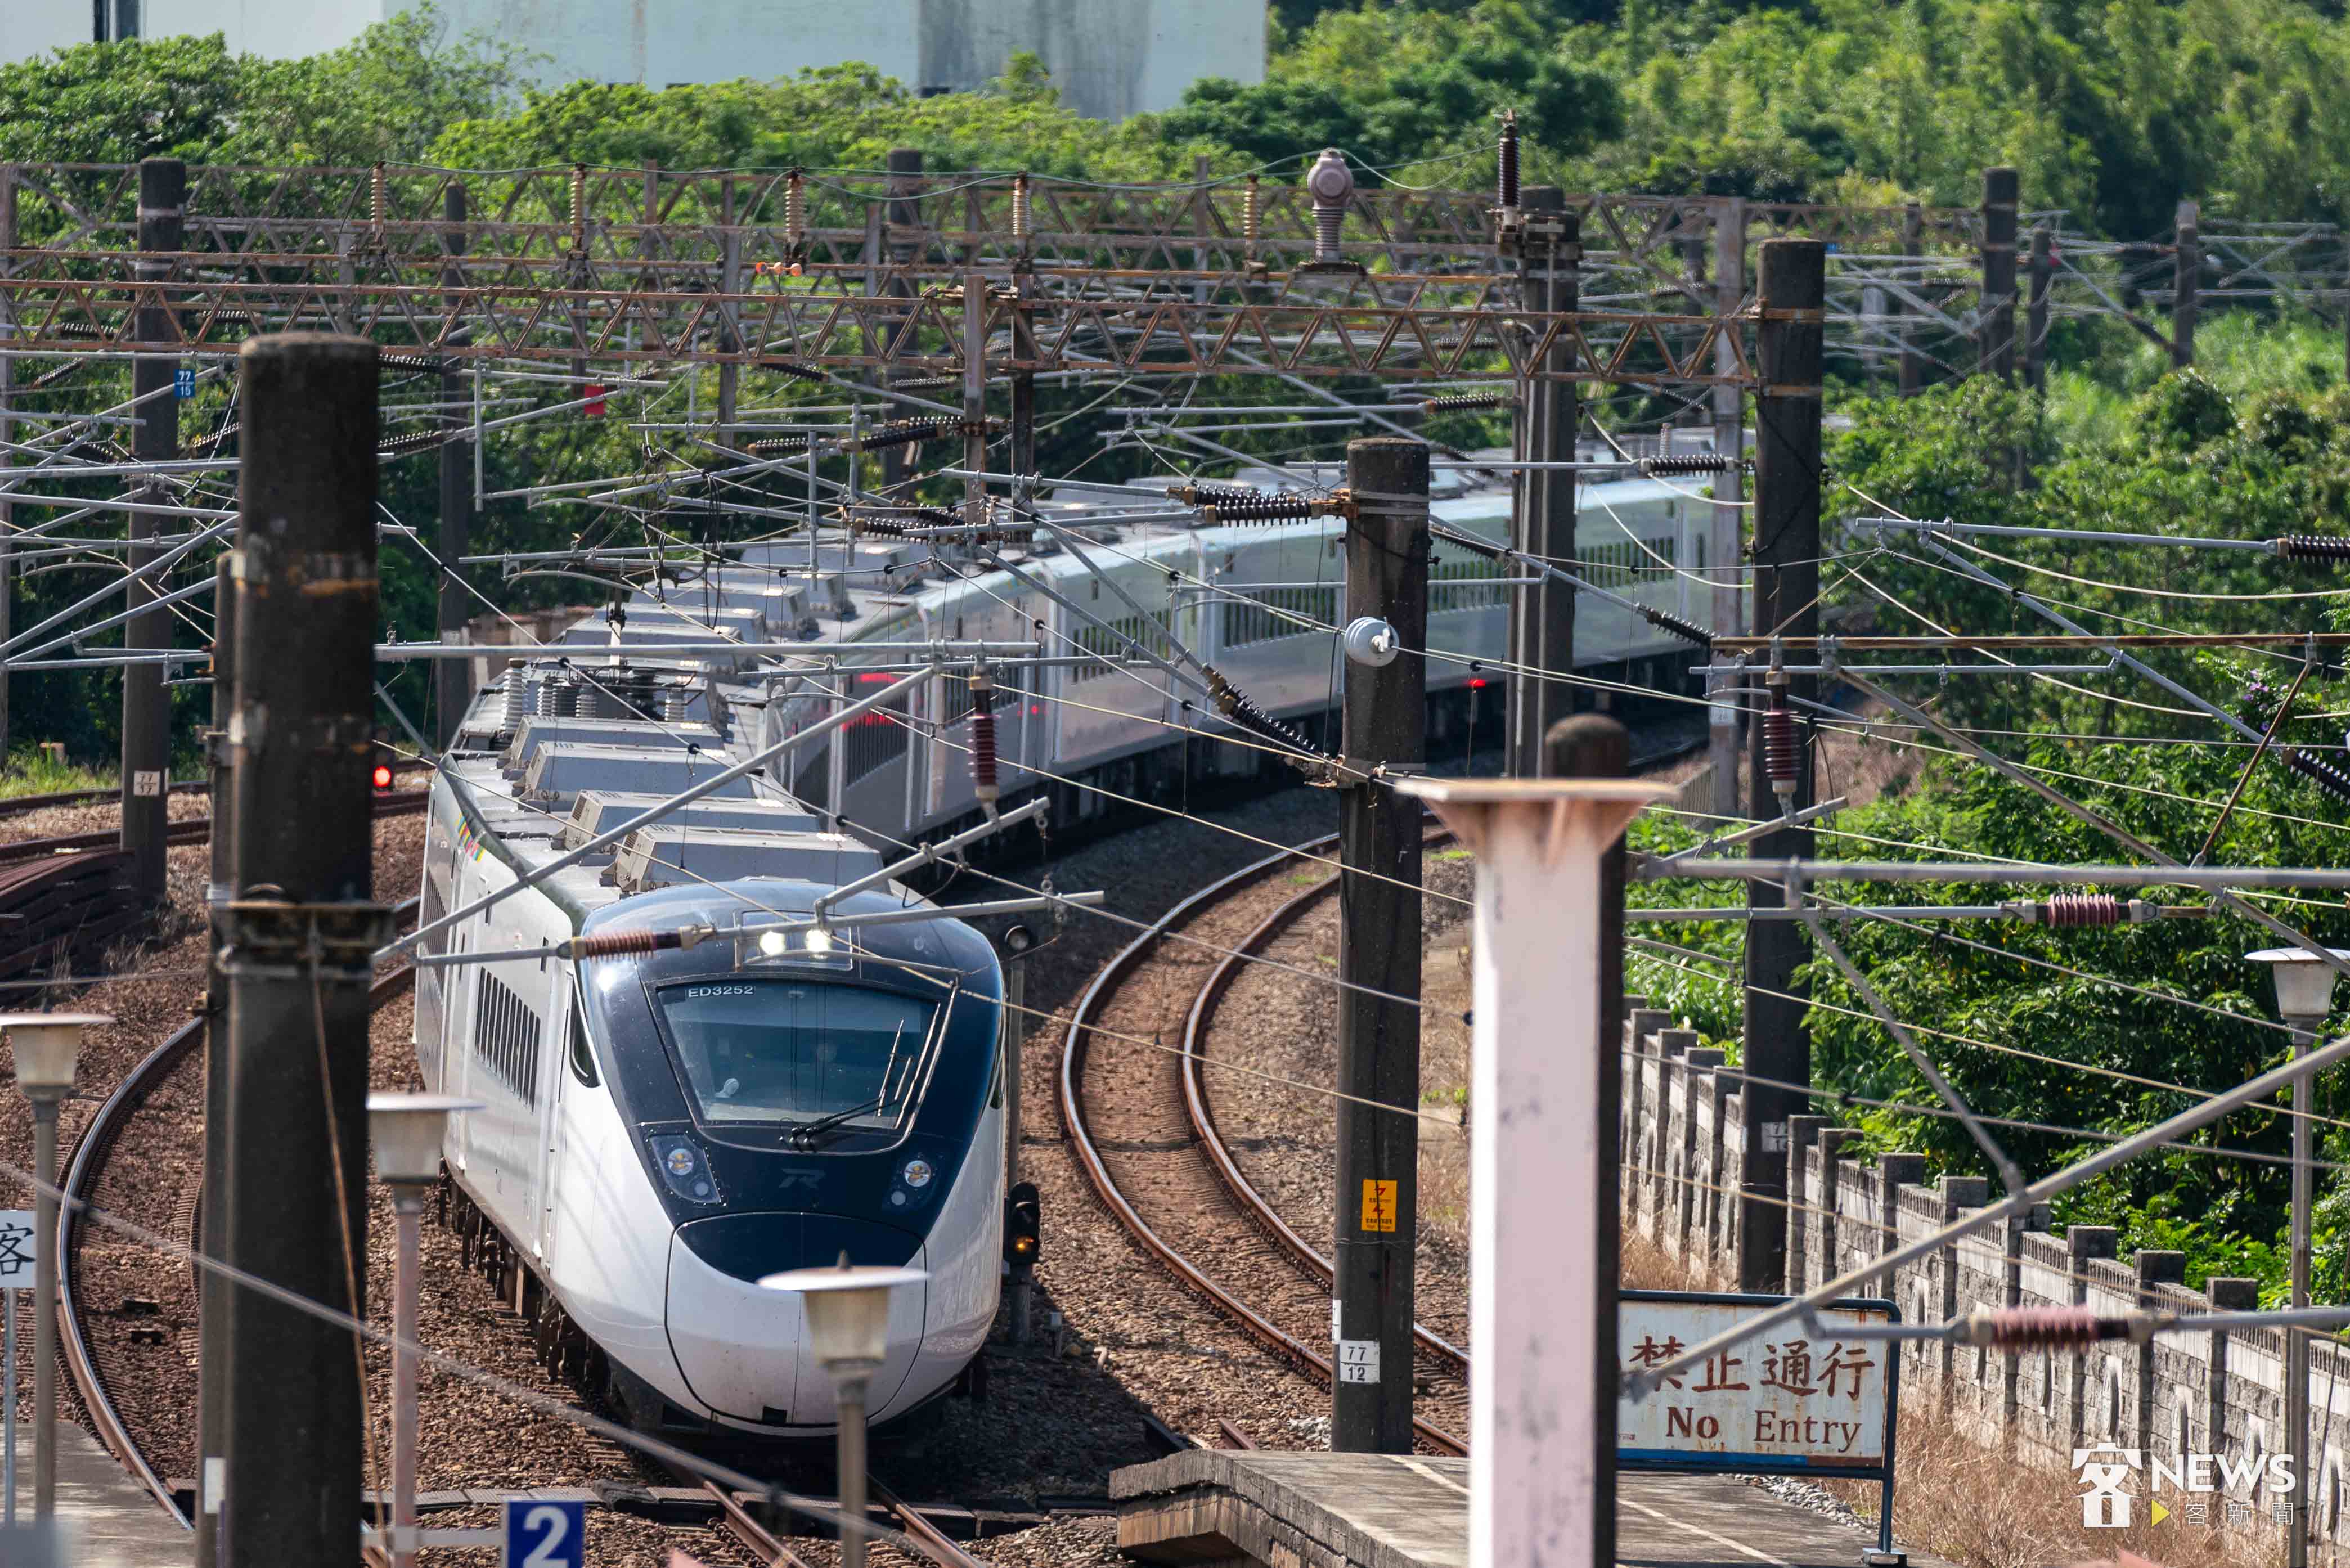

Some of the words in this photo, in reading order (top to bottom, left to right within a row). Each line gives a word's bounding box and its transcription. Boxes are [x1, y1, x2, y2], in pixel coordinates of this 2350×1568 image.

[178, 371, 191, 381] 77
[688, 986, 753, 998] ED3252
[0, 1223, 35, 1275] 客
[1348, 1346, 1367, 1361] 77
[1348, 1366, 1365, 1381] 12
[1666, 1406, 1719, 1439] No
[1753, 1410, 1862, 1453] Entry
[523, 1505, 570, 1568] 2
